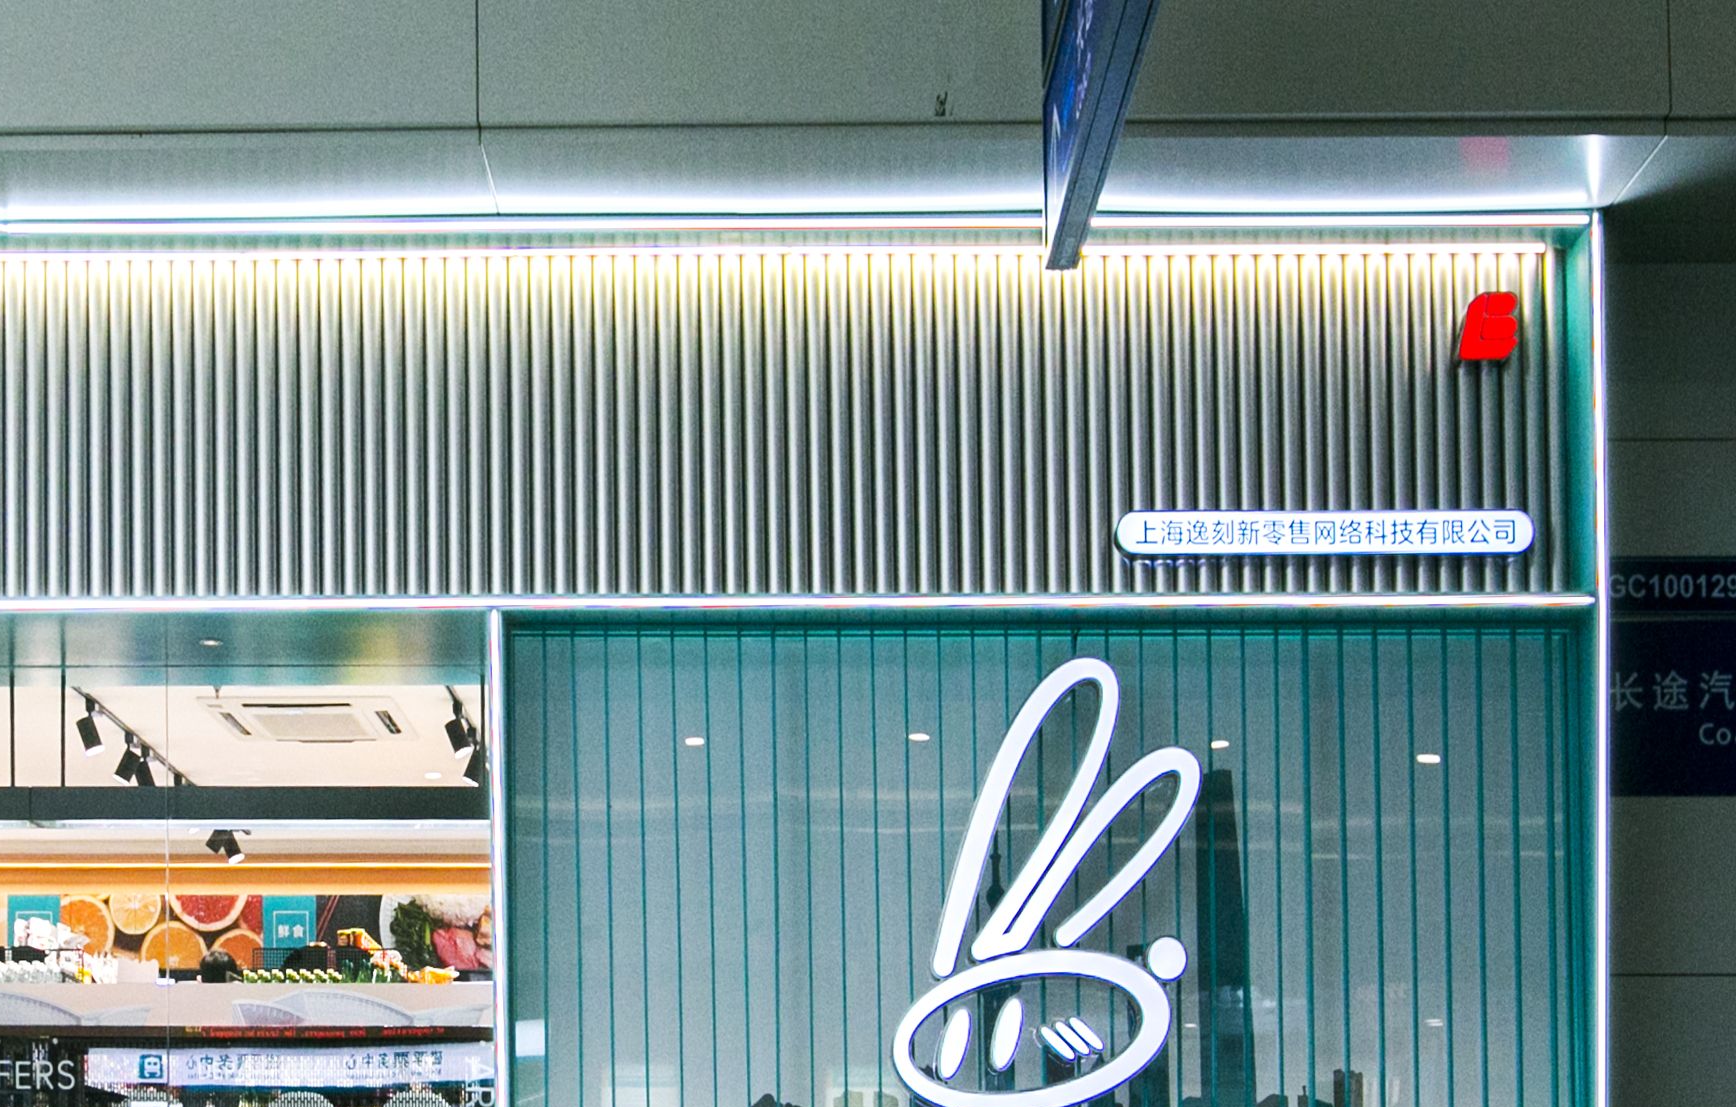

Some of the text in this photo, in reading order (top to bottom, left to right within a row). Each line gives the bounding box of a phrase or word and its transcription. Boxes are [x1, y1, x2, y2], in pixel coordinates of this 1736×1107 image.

[1134, 518, 1518, 546] 上海逸刻新零售网络科技有限公司
[1698, 722, 1736, 746] Co
